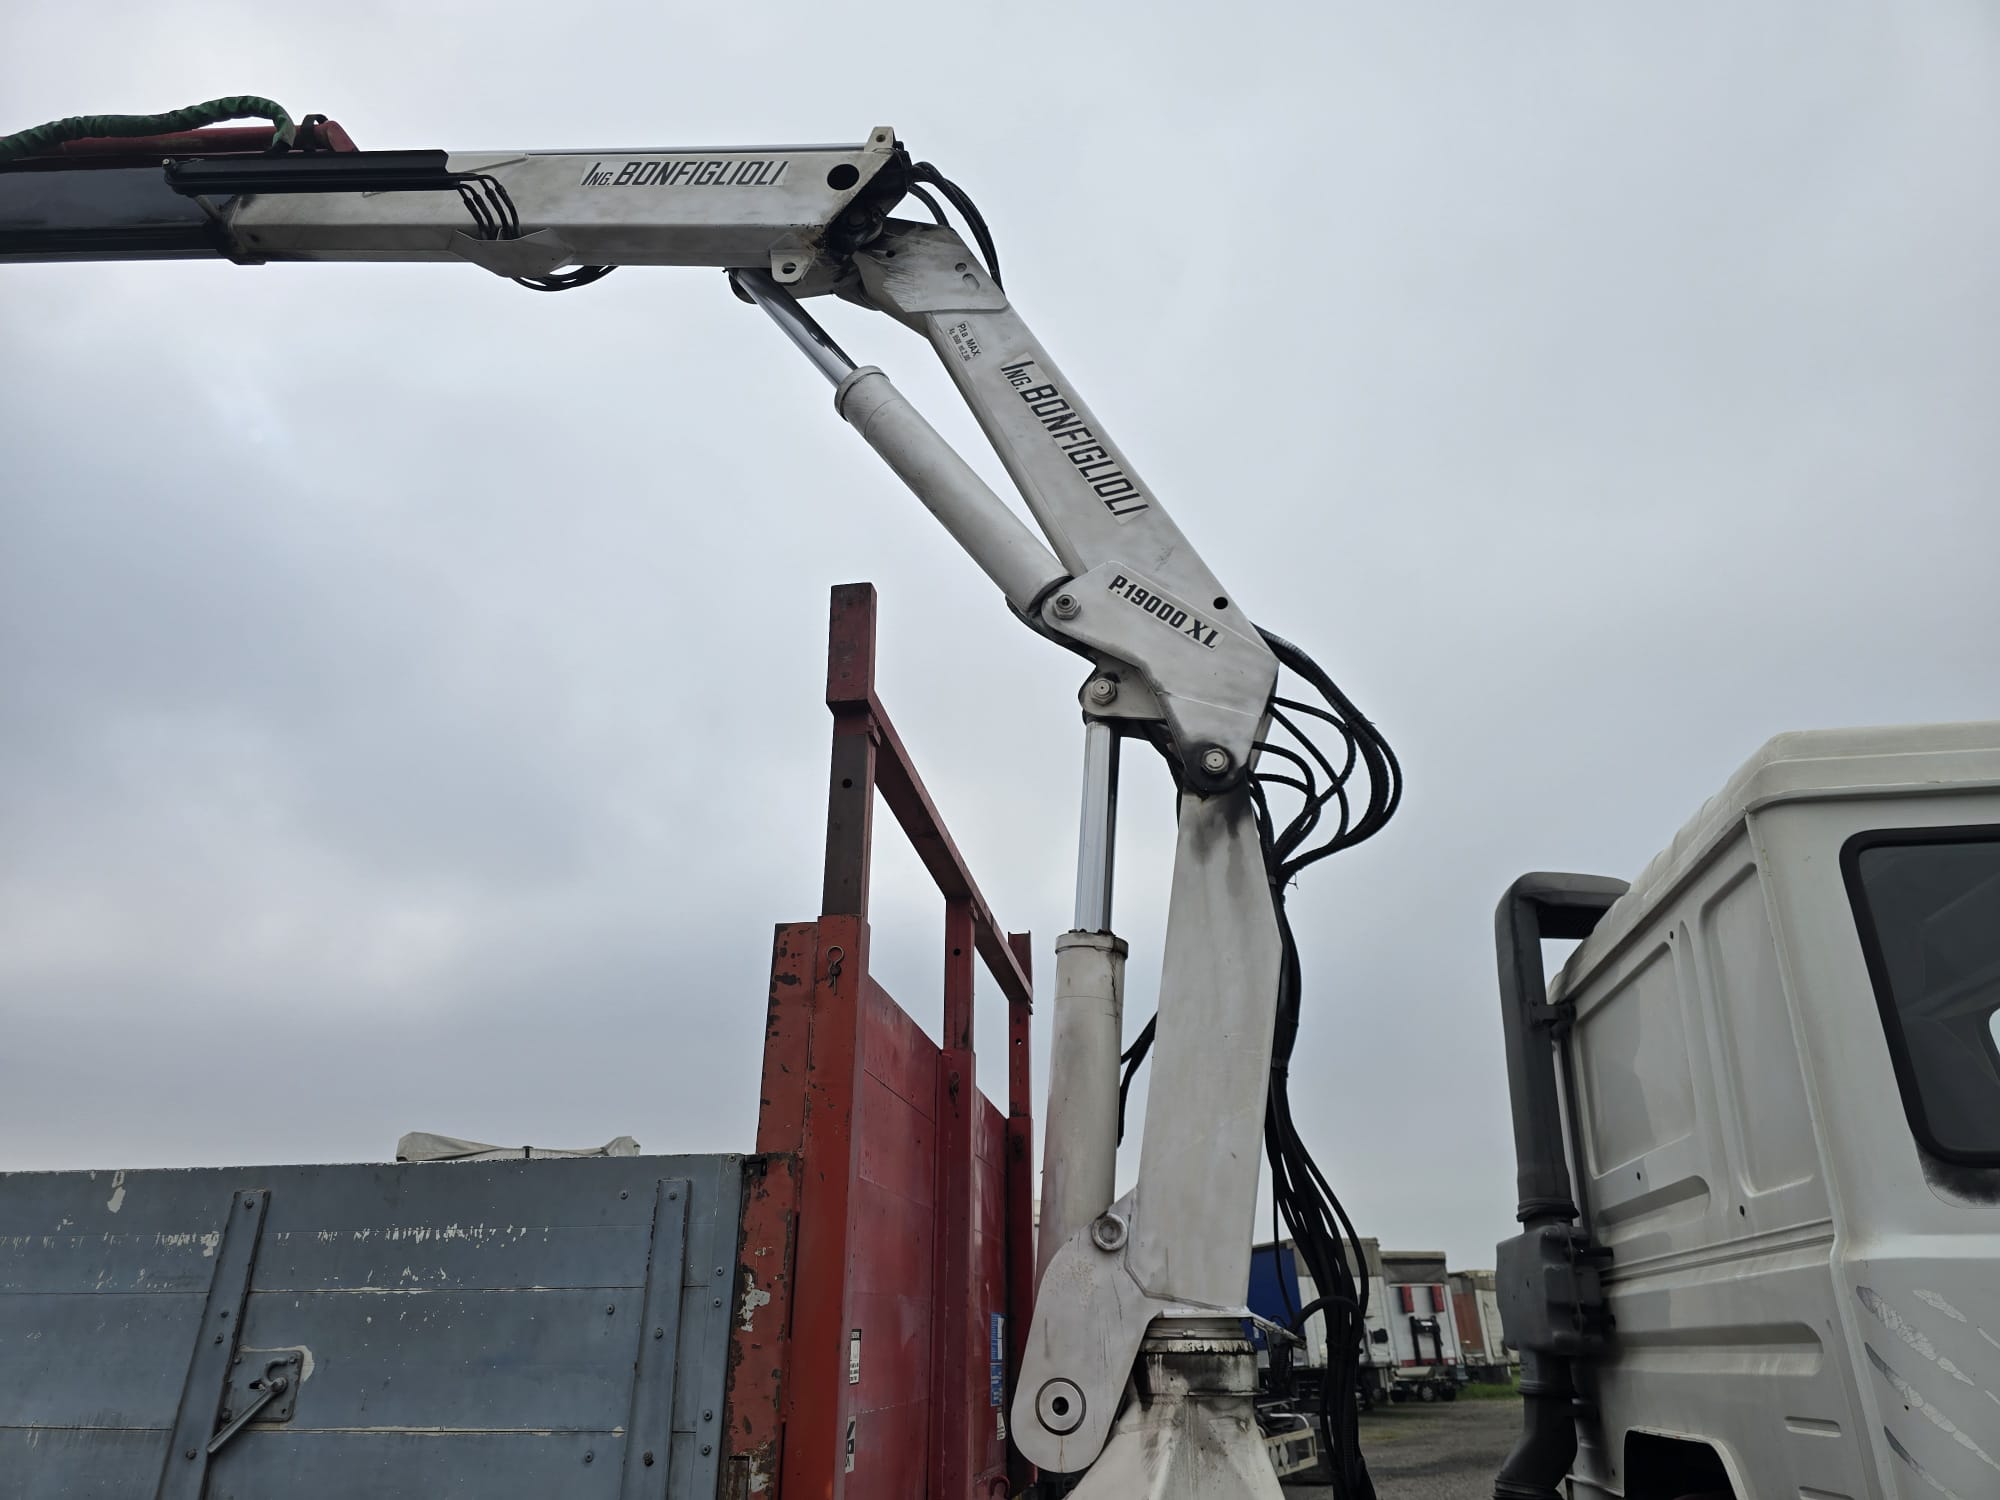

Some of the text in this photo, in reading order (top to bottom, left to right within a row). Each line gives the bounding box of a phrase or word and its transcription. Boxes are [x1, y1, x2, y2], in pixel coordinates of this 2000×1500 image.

[612, 160, 789, 186] BONFIGLIOLI
[965, 338, 981, 357] MAX
[1019, 383, 1149, 516] BONFIGLIOLI
[1108, 574, 1219, 649] P.19000 XL
